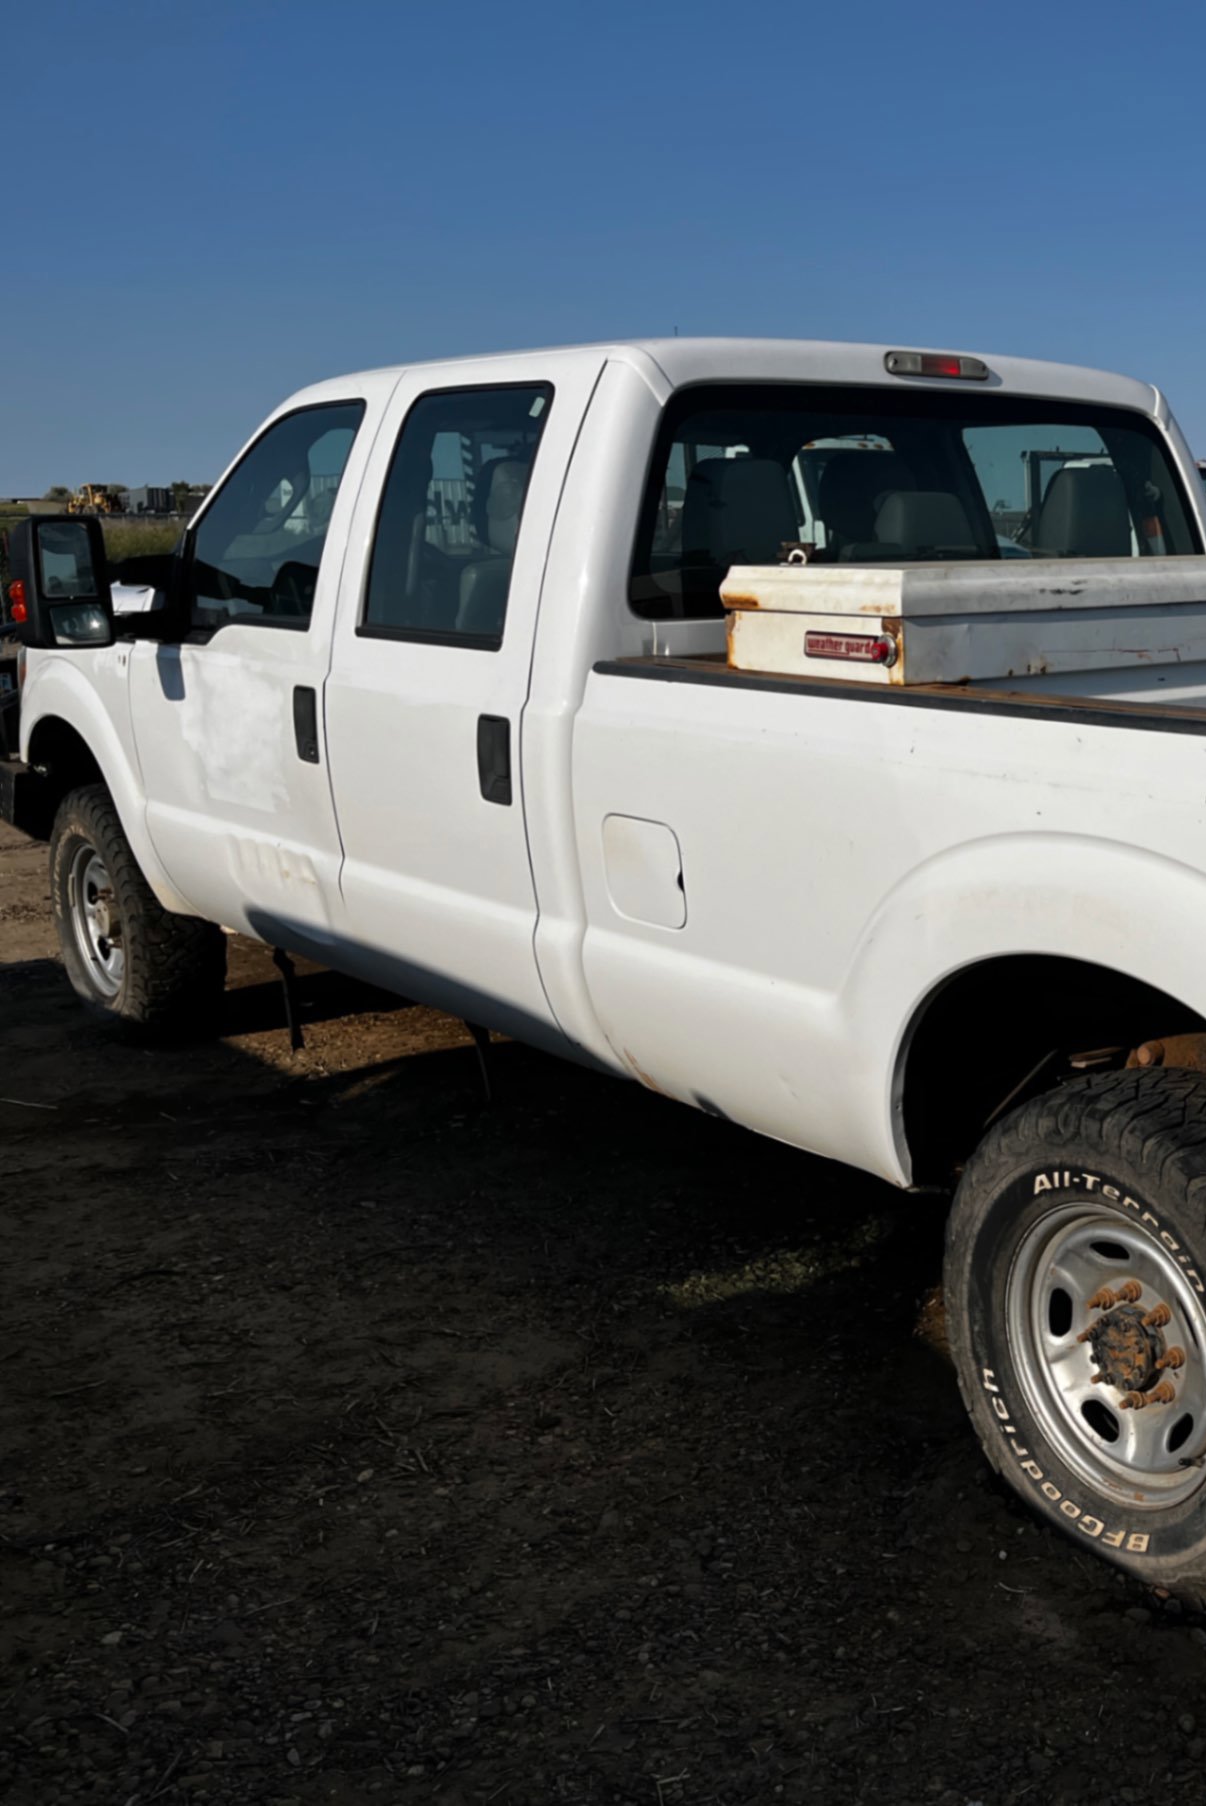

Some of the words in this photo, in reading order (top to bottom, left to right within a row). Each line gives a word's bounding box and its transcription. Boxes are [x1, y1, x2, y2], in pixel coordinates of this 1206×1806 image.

[807, 635, 843, 651] weather
[1033, 1170, 1206, 1293] All-Terrain
[982, 1367, 1152, 1554] BFGoodrich
